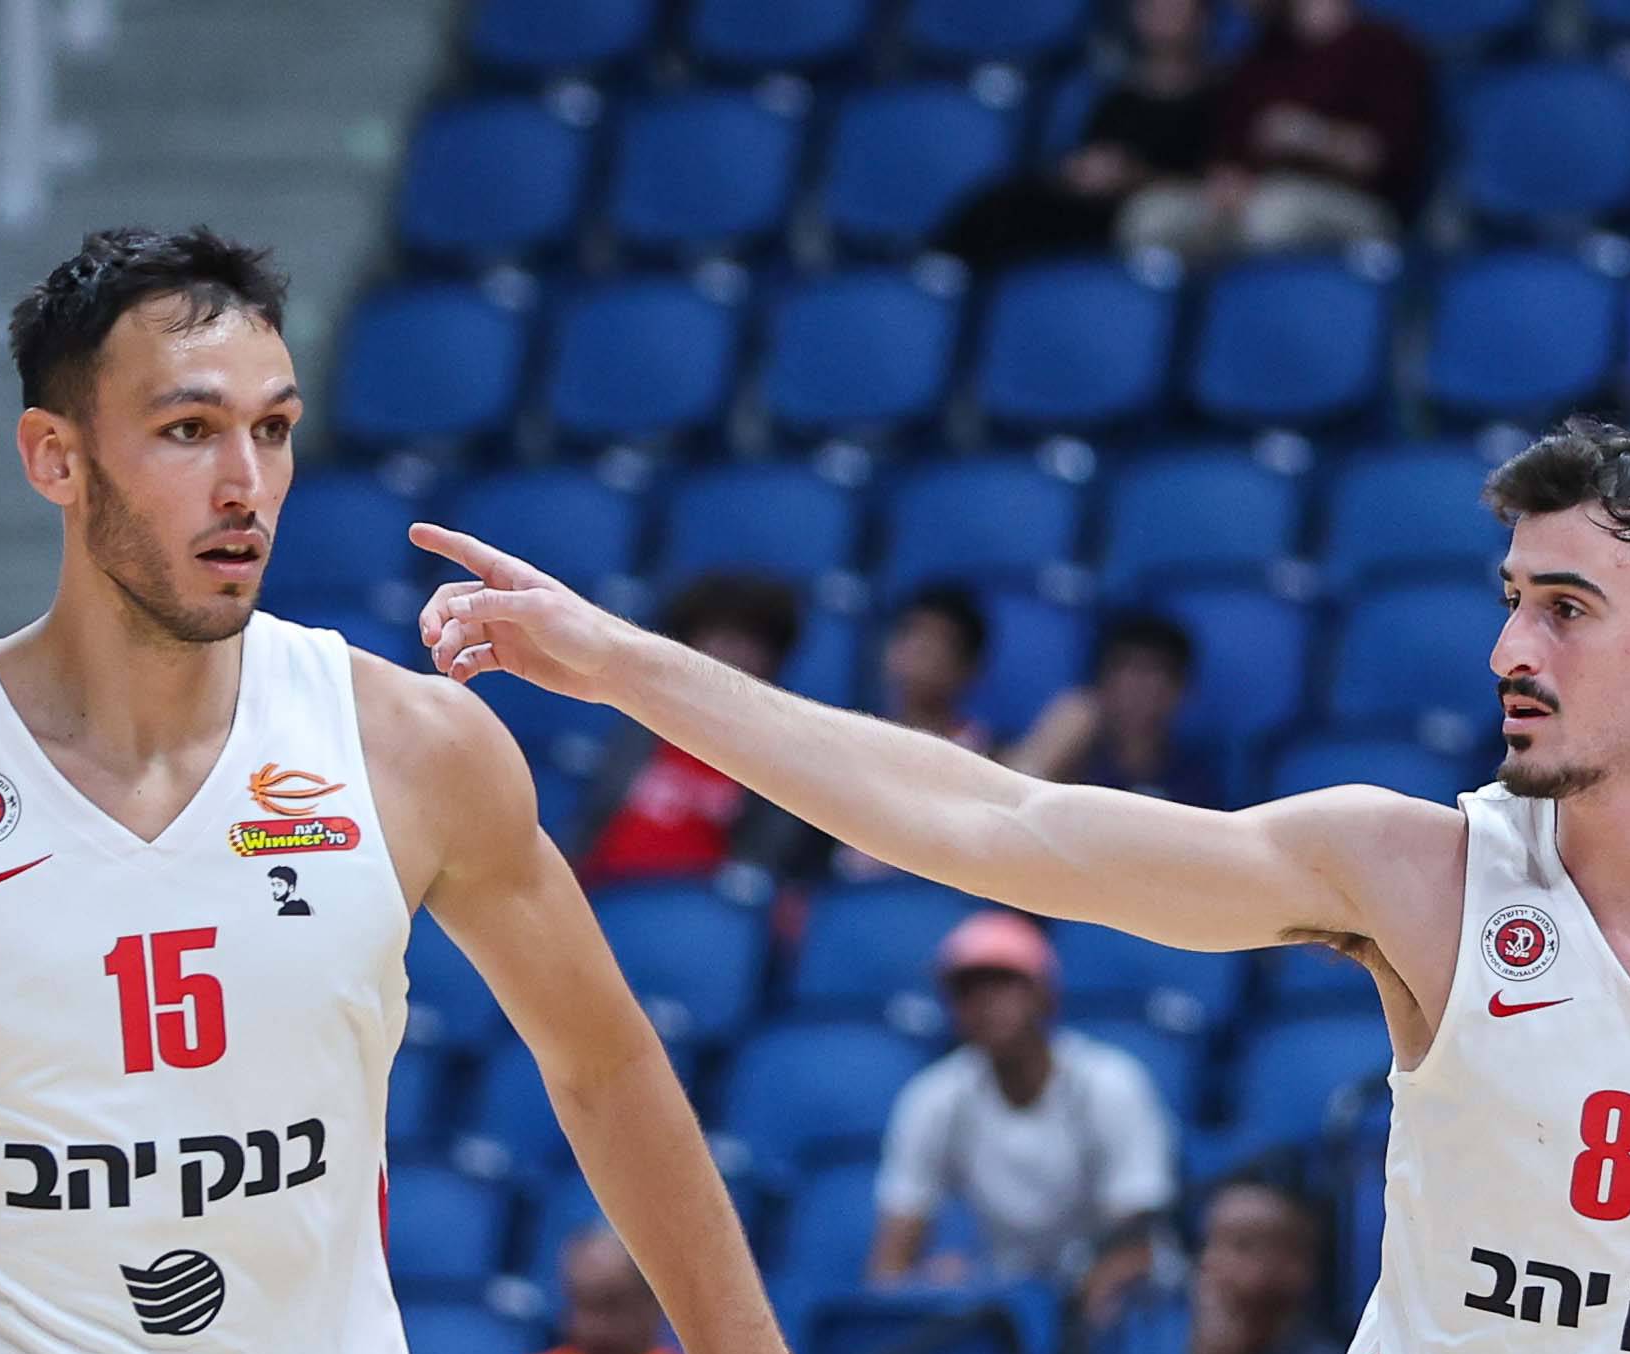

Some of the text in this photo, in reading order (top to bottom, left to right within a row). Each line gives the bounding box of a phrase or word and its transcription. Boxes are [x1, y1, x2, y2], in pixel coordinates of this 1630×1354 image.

[294, 820, 324, 836] ליגת
[326, 828, 347, 845] סל
[1492, 909, 1554, 935] הפועל ירושלים
[104, 926, 227, 1075] 15
[3, 1117, 326, 1217] בנק יהב
[1464, 1246, 1611, 1328] יהב
